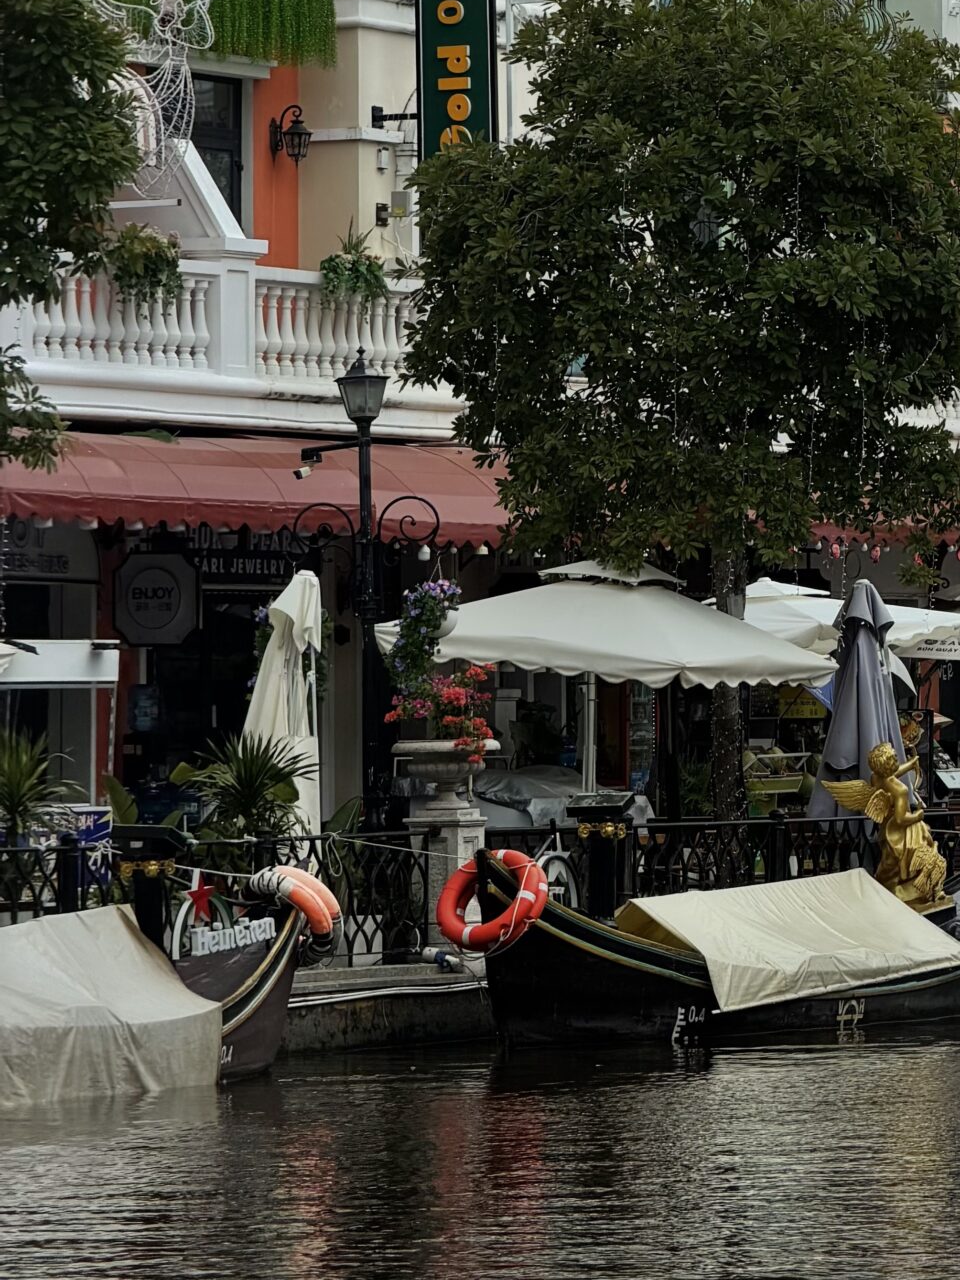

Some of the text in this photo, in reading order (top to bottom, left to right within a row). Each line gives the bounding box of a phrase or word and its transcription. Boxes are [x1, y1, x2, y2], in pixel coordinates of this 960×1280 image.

[437, 44, 472, 154] Gold
[230, 558, 286, 576] JEWELRY
[132, 587, 174, 600] ENJOY
[688, 1005, 706, 1024] 0.4
